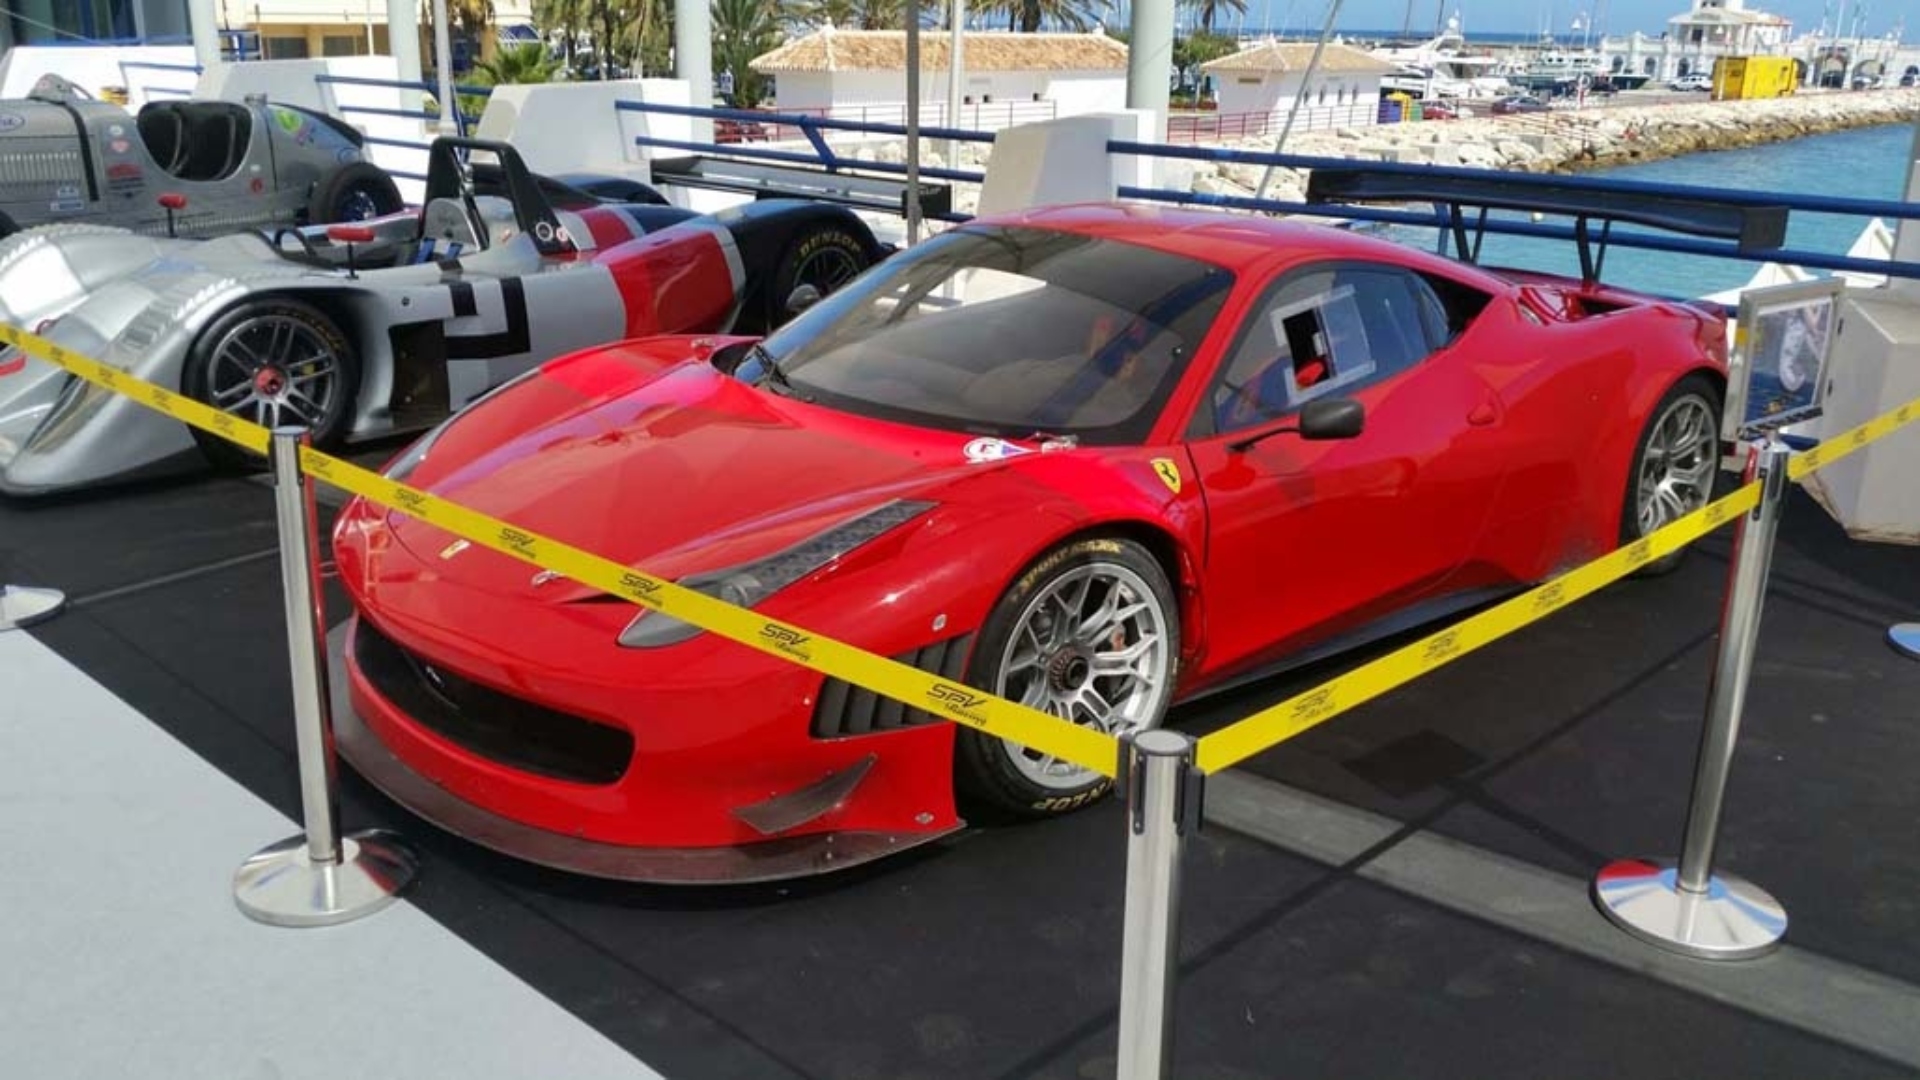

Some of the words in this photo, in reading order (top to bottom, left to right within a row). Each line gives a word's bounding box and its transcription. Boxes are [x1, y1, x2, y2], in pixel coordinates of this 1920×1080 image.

[800, 231, 861, 257] DUNLOP
[619, 573, 662, 594] SPV
[758, 622, 811, 646] SPV
[926, 683, 987, 709] SPV
